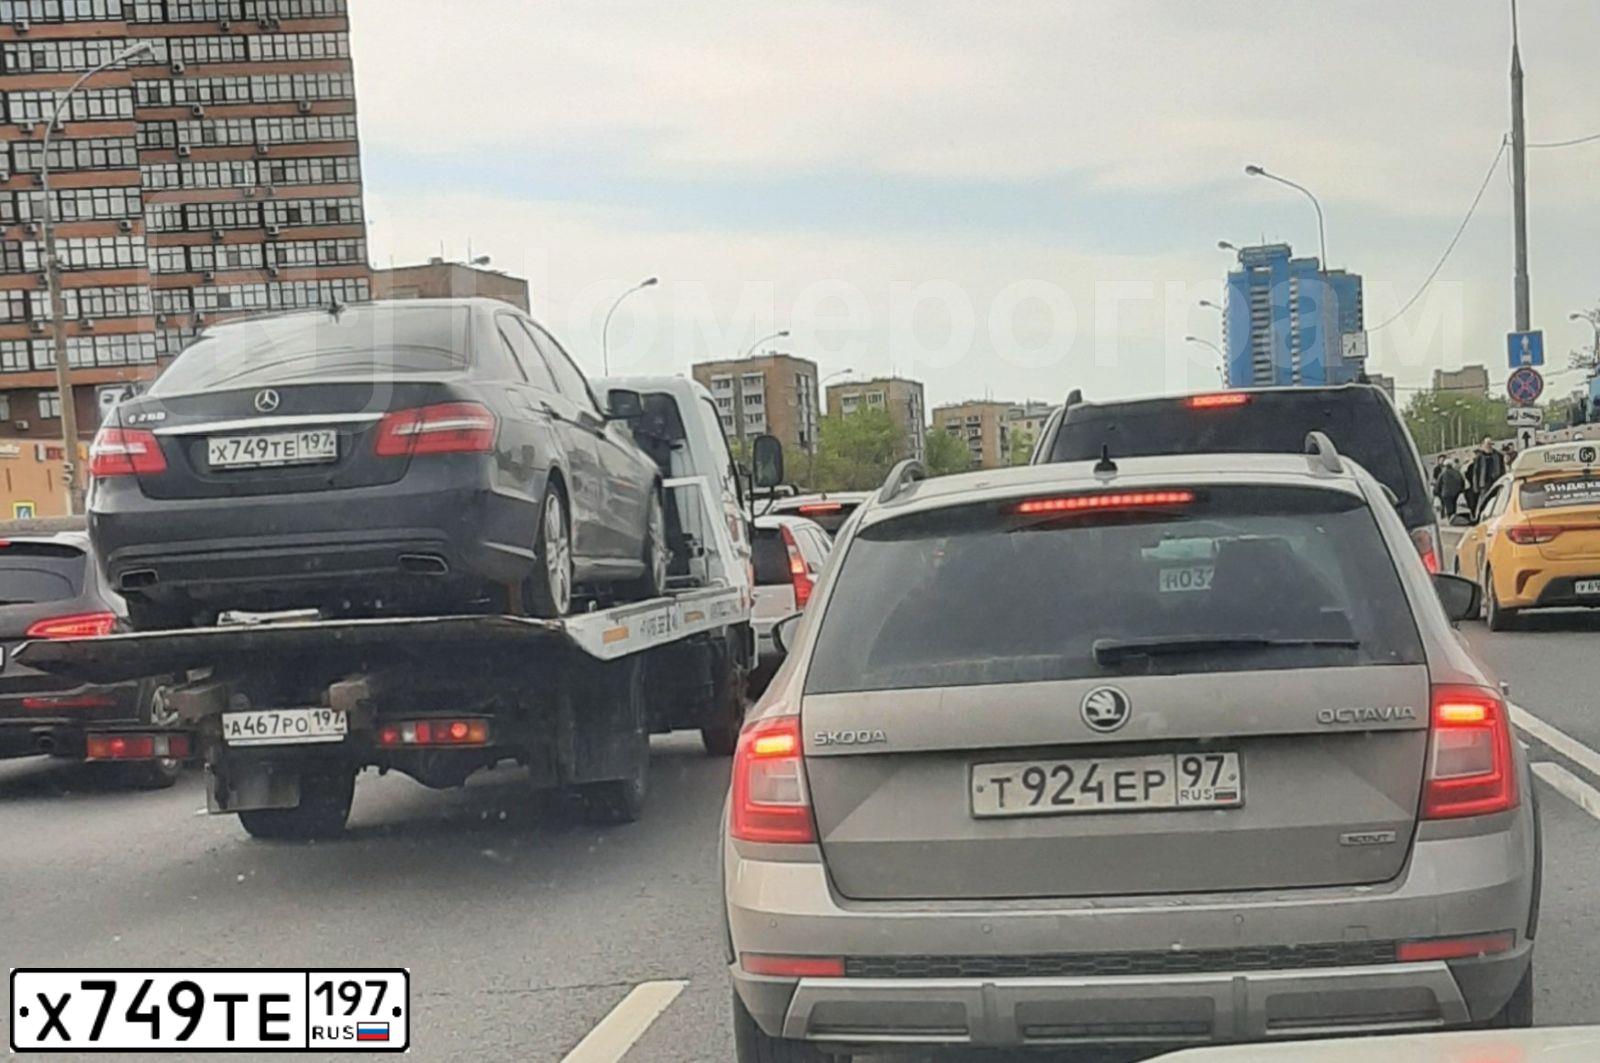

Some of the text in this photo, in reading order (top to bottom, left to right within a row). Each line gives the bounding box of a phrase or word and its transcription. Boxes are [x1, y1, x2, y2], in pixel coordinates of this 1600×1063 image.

[301, 432, 330, 449] 197
[1317, 706, 1416, 724] OCTAVIA
[1181, 755, 1226, 788] 97
[1180, 788, 1213, 801] RUS
